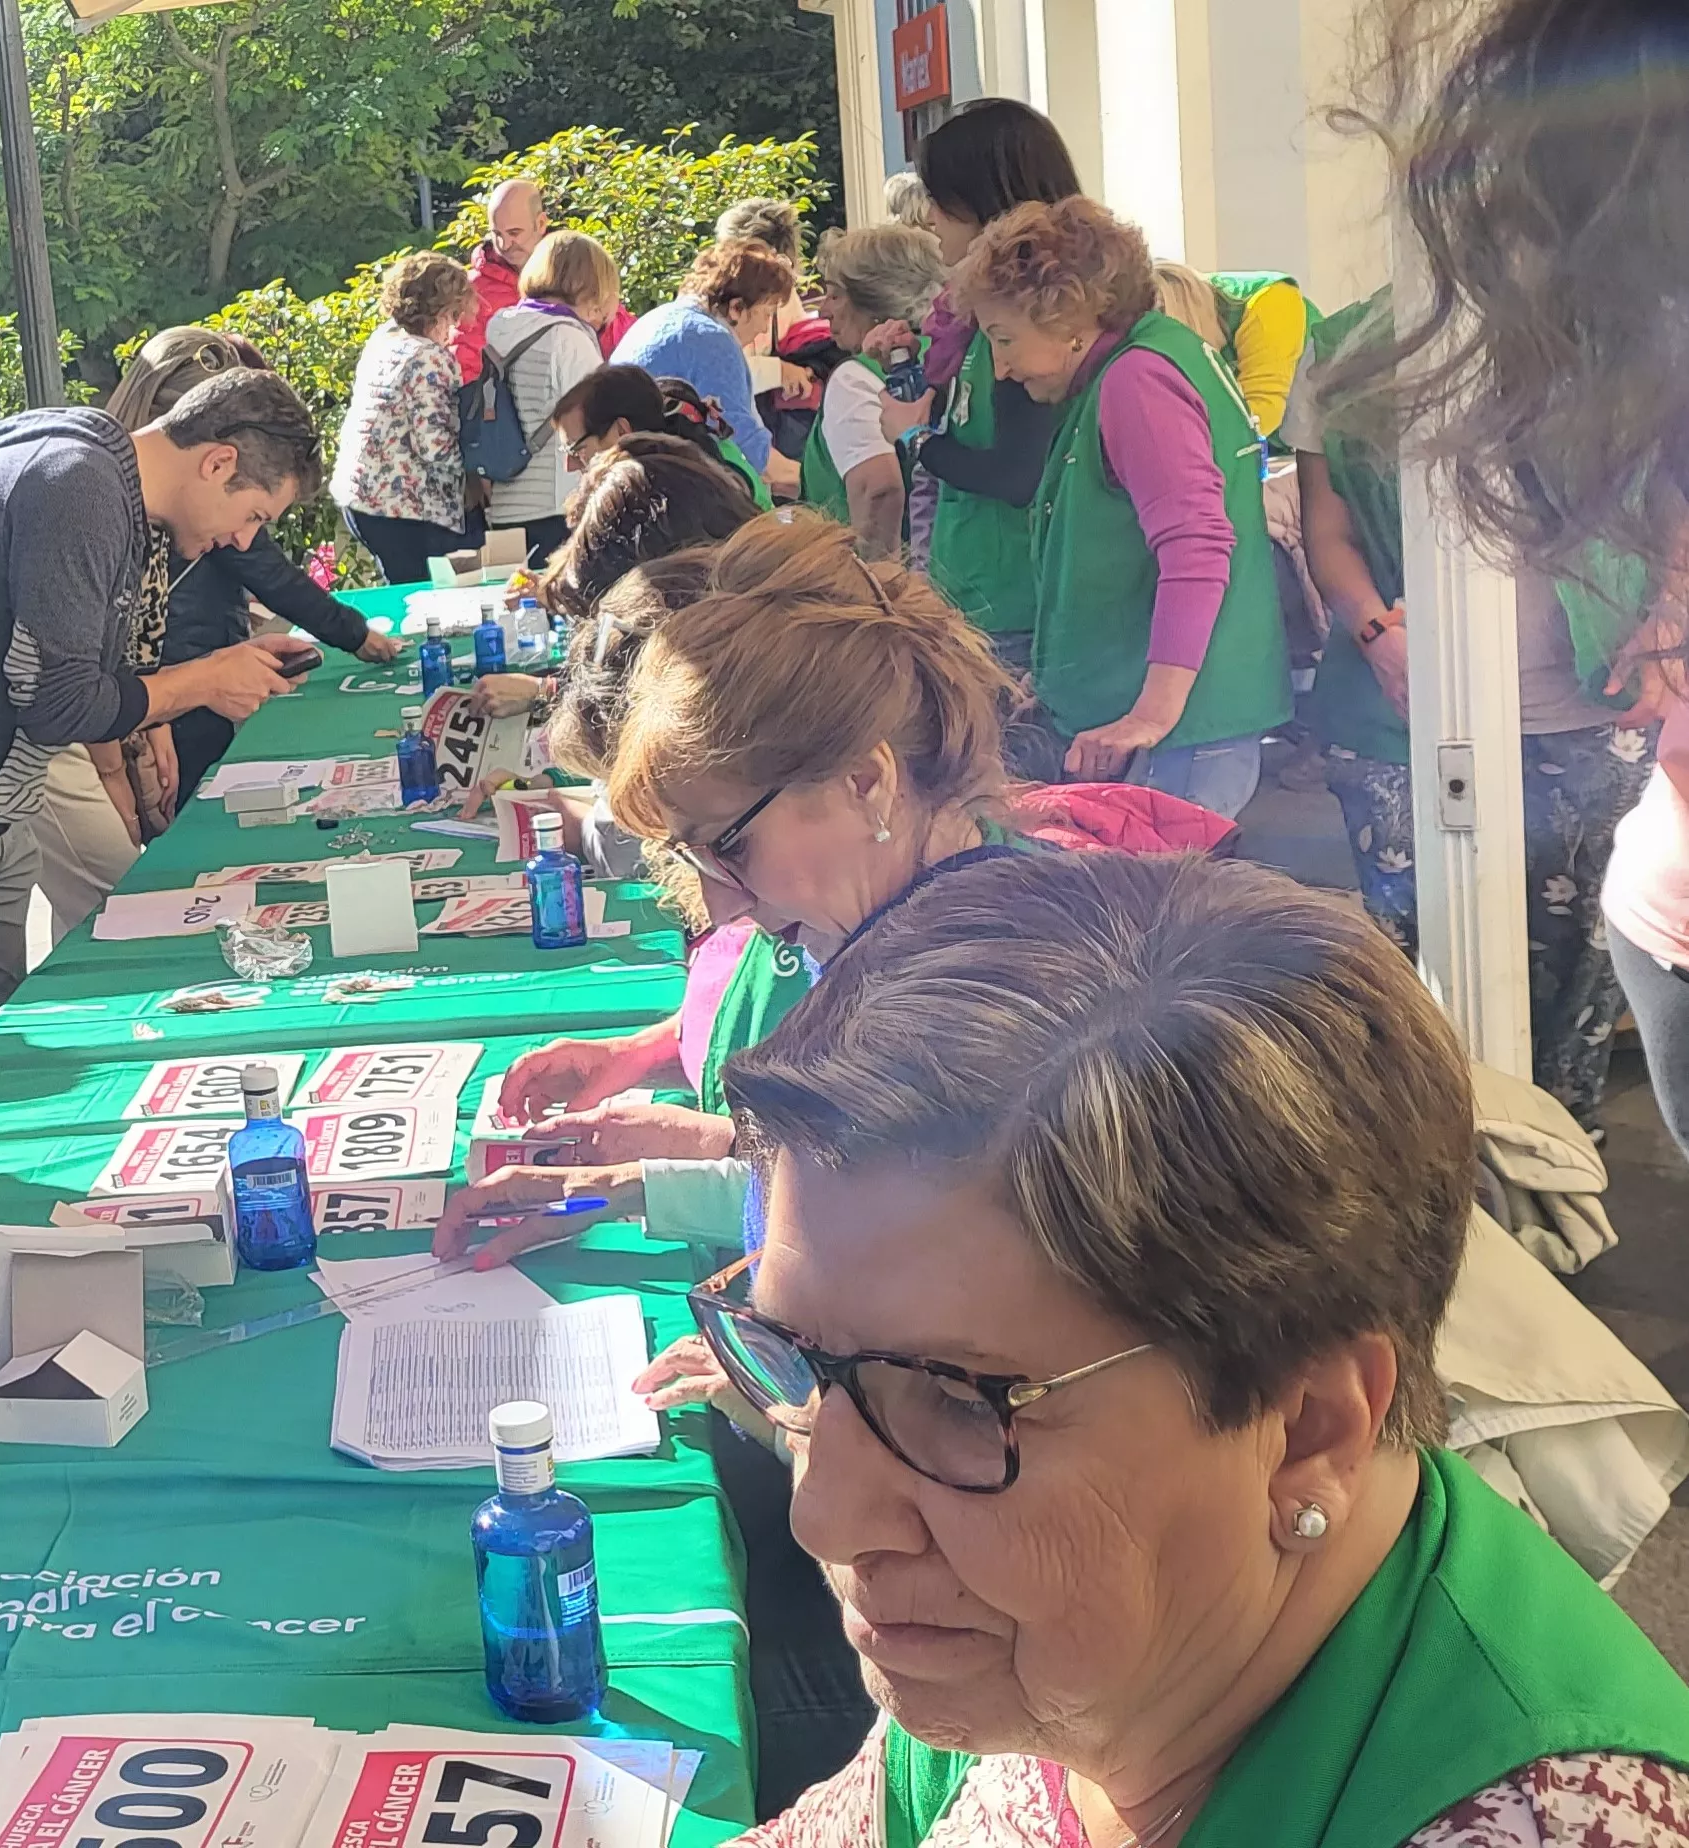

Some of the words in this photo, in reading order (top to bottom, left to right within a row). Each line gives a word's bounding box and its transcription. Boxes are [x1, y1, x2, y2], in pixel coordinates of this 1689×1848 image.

[437, 699, 485, 788] 245
[353, 1054, 433, 1098] 1751
[159, 1127, 238, 1181] 1654
[338, 1112, 407, 1170] 1809
[111, 1600, 157, 1638] el
[50, 1748, 111, 1816] CÁNCER
[75, 1747, 229, 1848] 00
[373, 1761, 423, 1832] CÁNCER
[46, 1817, 70, 1840] EL
